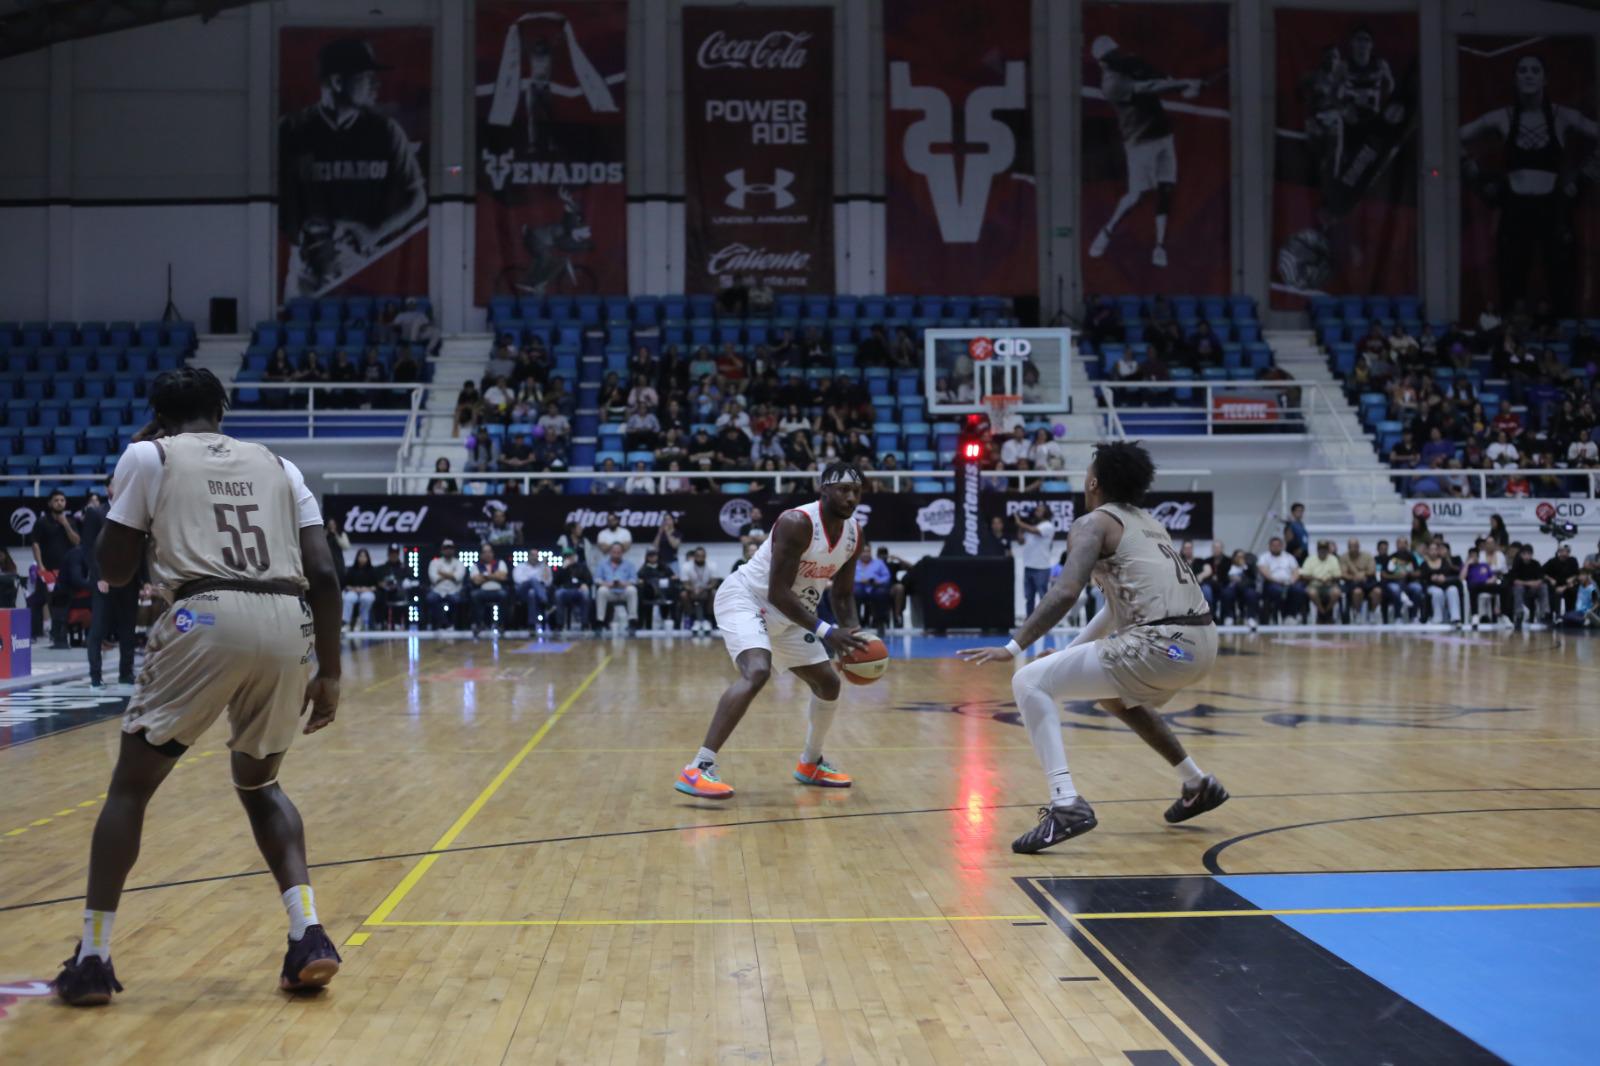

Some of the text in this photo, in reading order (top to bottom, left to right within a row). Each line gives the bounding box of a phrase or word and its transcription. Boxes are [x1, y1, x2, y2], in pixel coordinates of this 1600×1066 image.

[697, 31, 813, 69] Coca-Cola
[705, 100, 807, 122] POWER
[752, 122, 807, 144] ADE
[707, 242, 811, 274] Caliente
[993, 339, 1031, 356] CID
[208, 480, 253, 496] BRACEY
[344, 506, 428, 533] telcel
[1557, 503, 1585, 517] CID
[213, 503, 270, 571] 55
